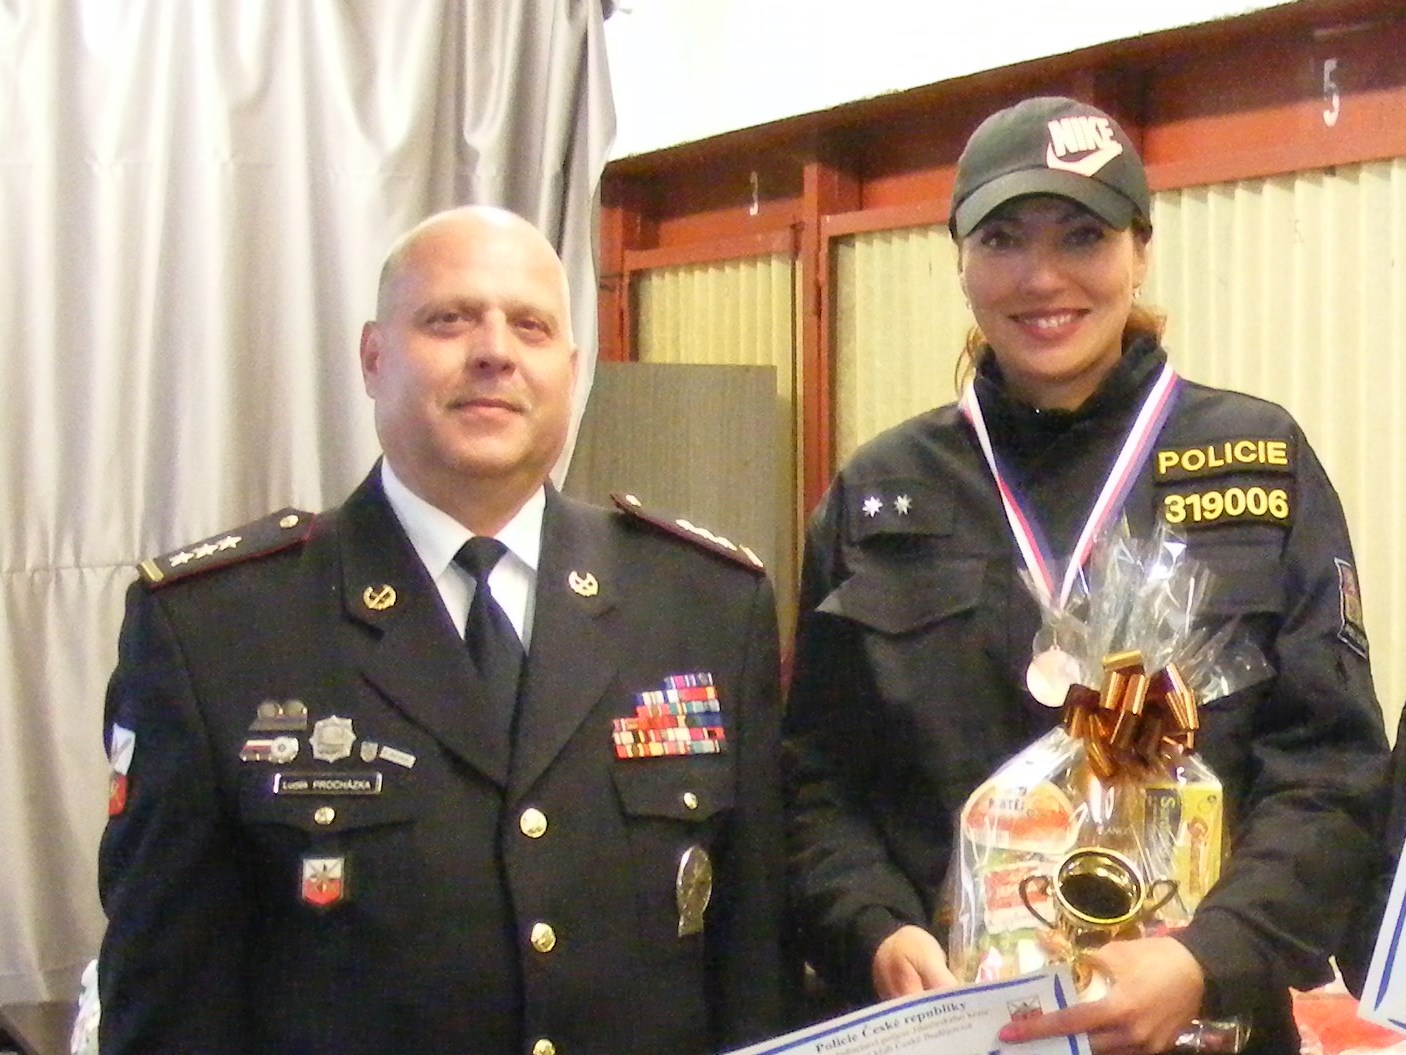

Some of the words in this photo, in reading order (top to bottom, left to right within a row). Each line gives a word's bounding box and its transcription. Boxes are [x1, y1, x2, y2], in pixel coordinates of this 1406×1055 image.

[1047, 116, 1116, 157] NIKE
[1157, 440, 1289, 475] POLICIE
[1164, 487, 1290, 523] 319006
[815, 1033, 859, 1054] Policie
[861, 1017, 901, 1038] České
[903, 1001, 968, 1025] republiky
